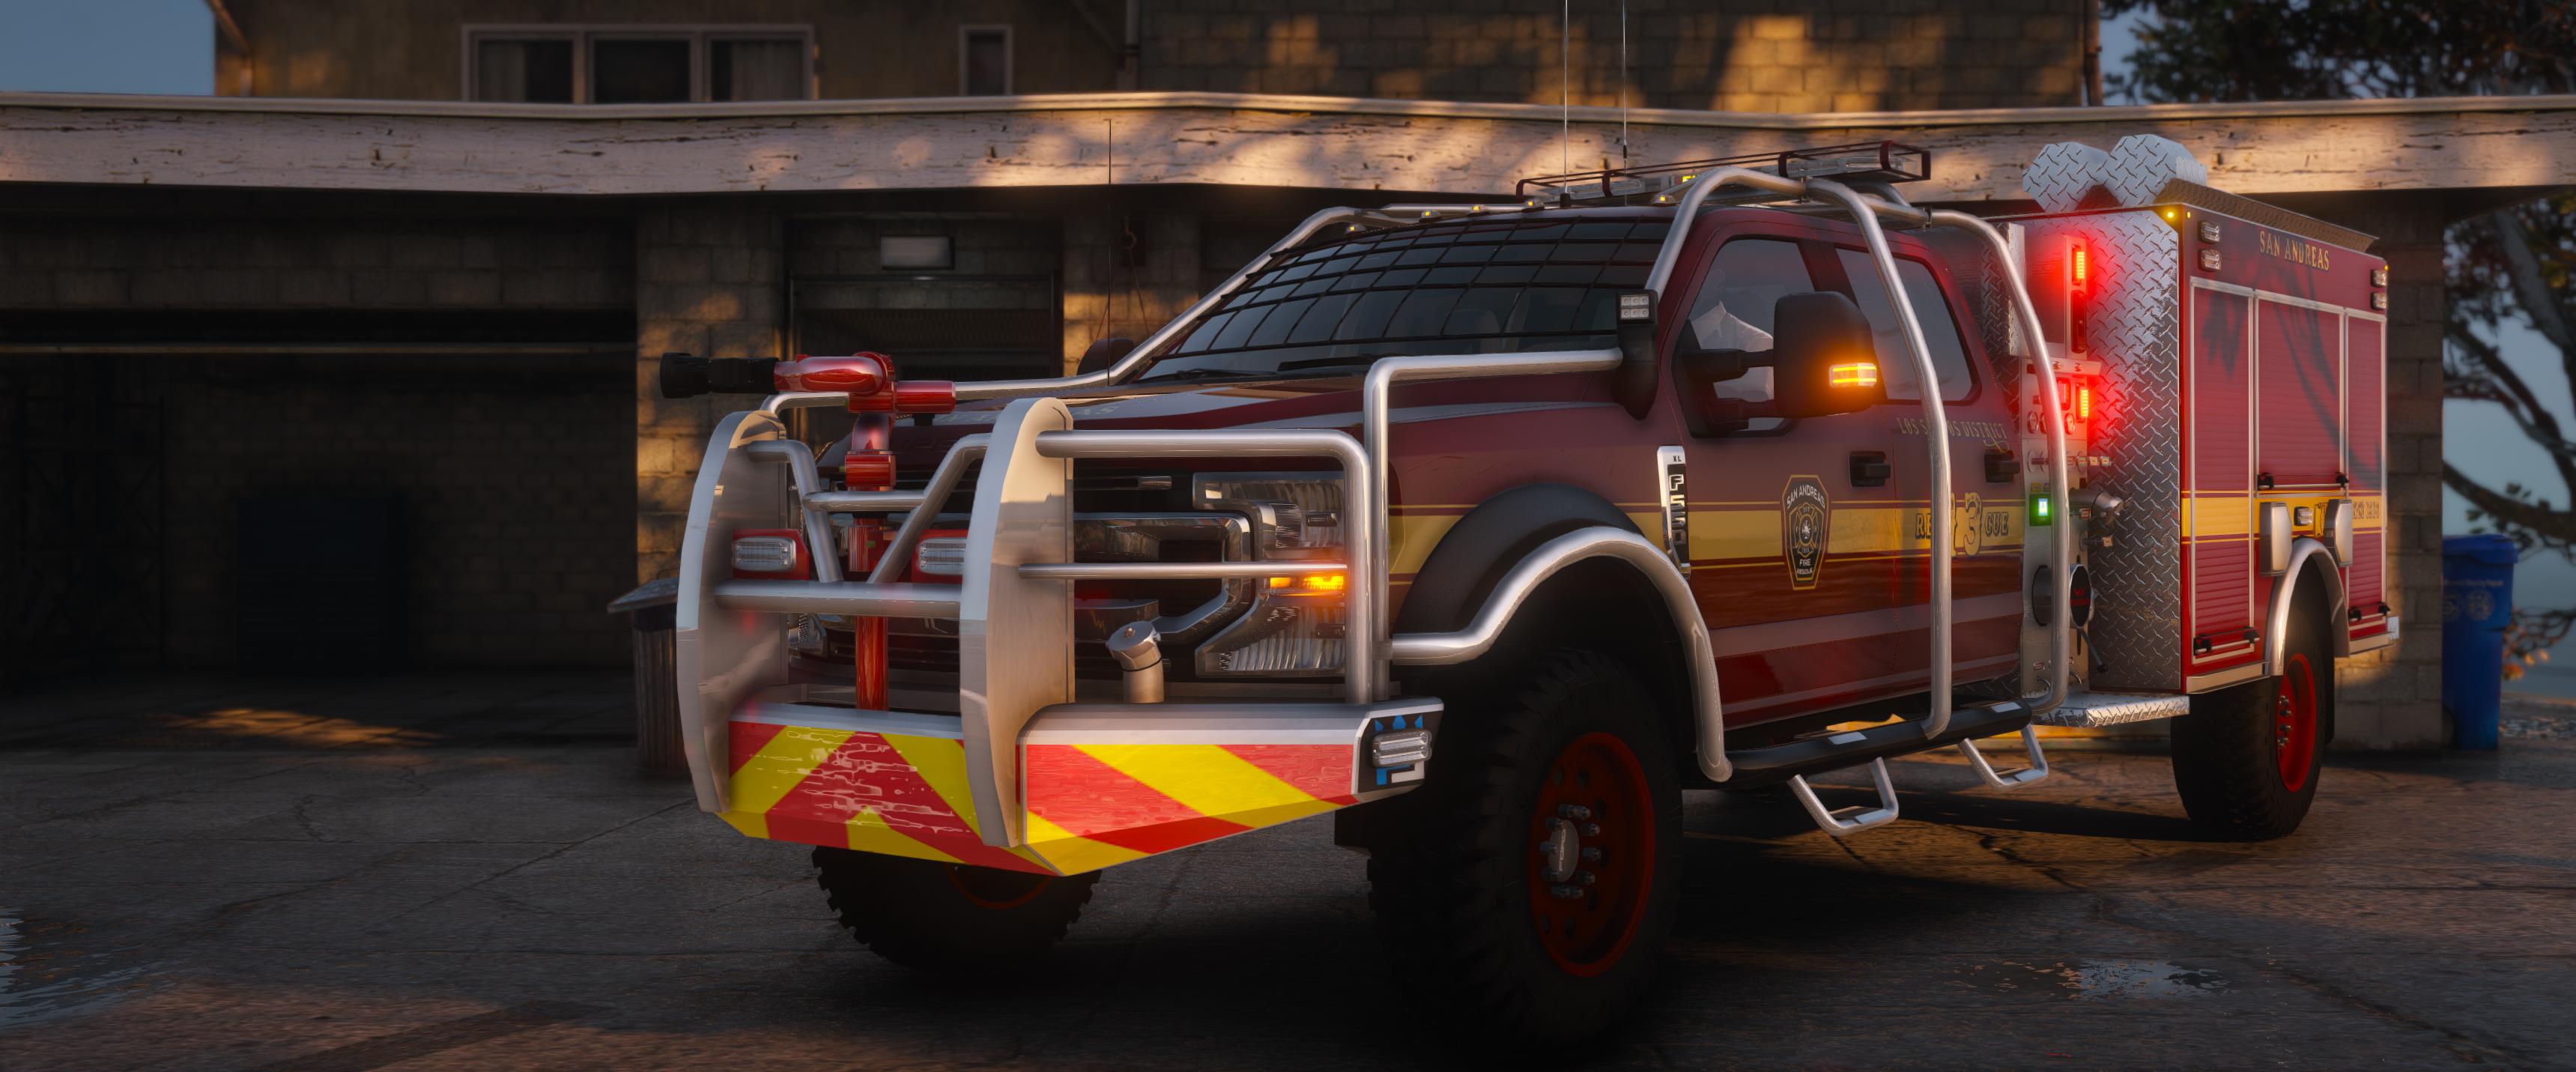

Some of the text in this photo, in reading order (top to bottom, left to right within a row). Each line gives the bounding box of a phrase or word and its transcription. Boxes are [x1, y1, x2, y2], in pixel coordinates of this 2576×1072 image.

[2260, 231, 2330, 270] SAN ANDREAS
[1896, 417, 1919, 435] LOS
[1960, 421, 2010, 452] DISTRICT
[1786, 484, 1825, 509] SAN ANDREAS
[1799, 558, 1811, 566] FIRE
